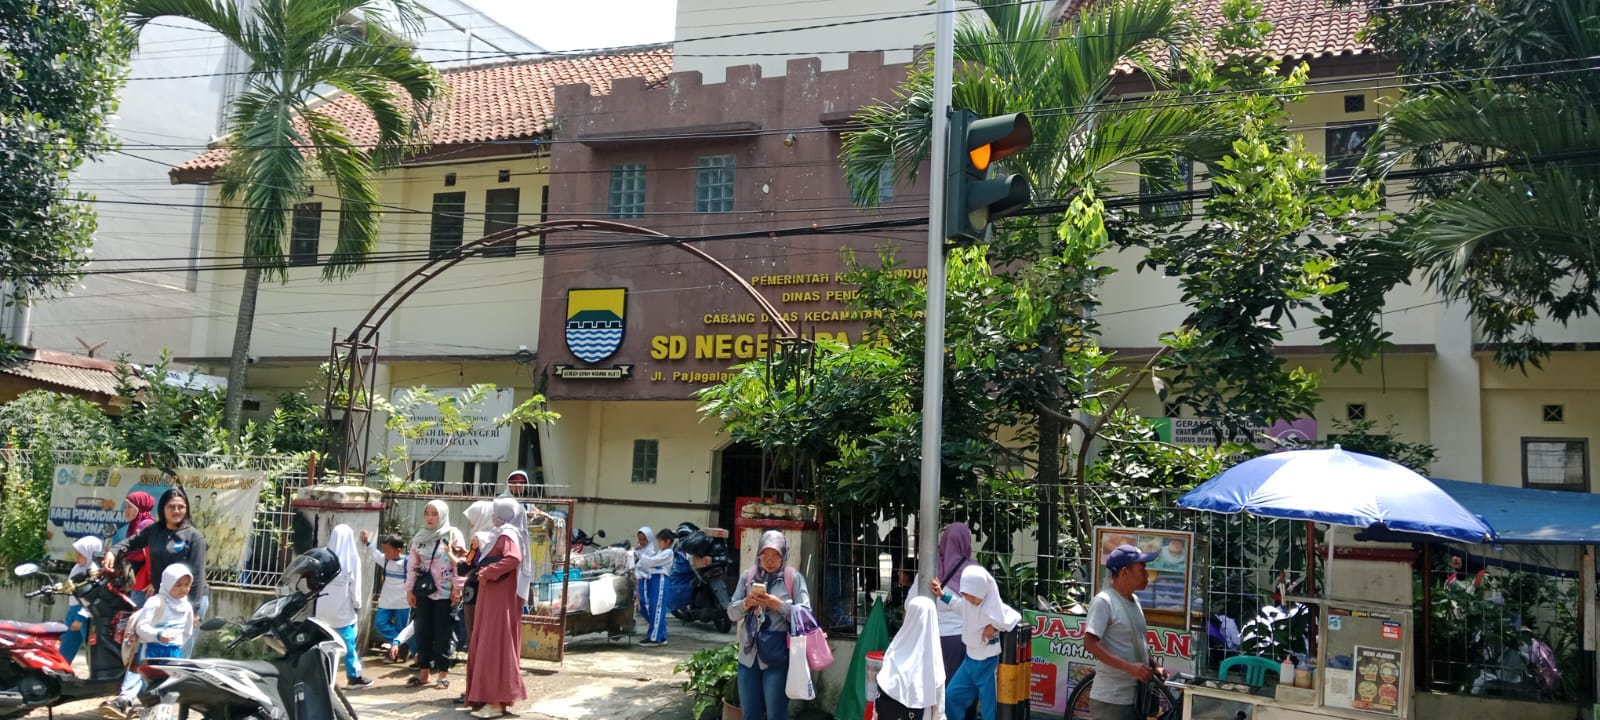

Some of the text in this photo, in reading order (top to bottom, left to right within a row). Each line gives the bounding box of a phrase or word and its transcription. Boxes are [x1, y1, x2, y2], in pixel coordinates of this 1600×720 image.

[751, 273, 830, 286] PEMERINTAH
[782, 291, 820, 302] DINAS
[703, 313, 756, 325] CABANG
[761, 312, 798, 323] DAS
[650, 334, 688, 360] SD
[694, 332, 808, 360] NEGE
[651, 371, 666, 382] Jl.
[63, 521, 104, 534] NASIONA
[1031, 616, 1192, 659] JAJAN
